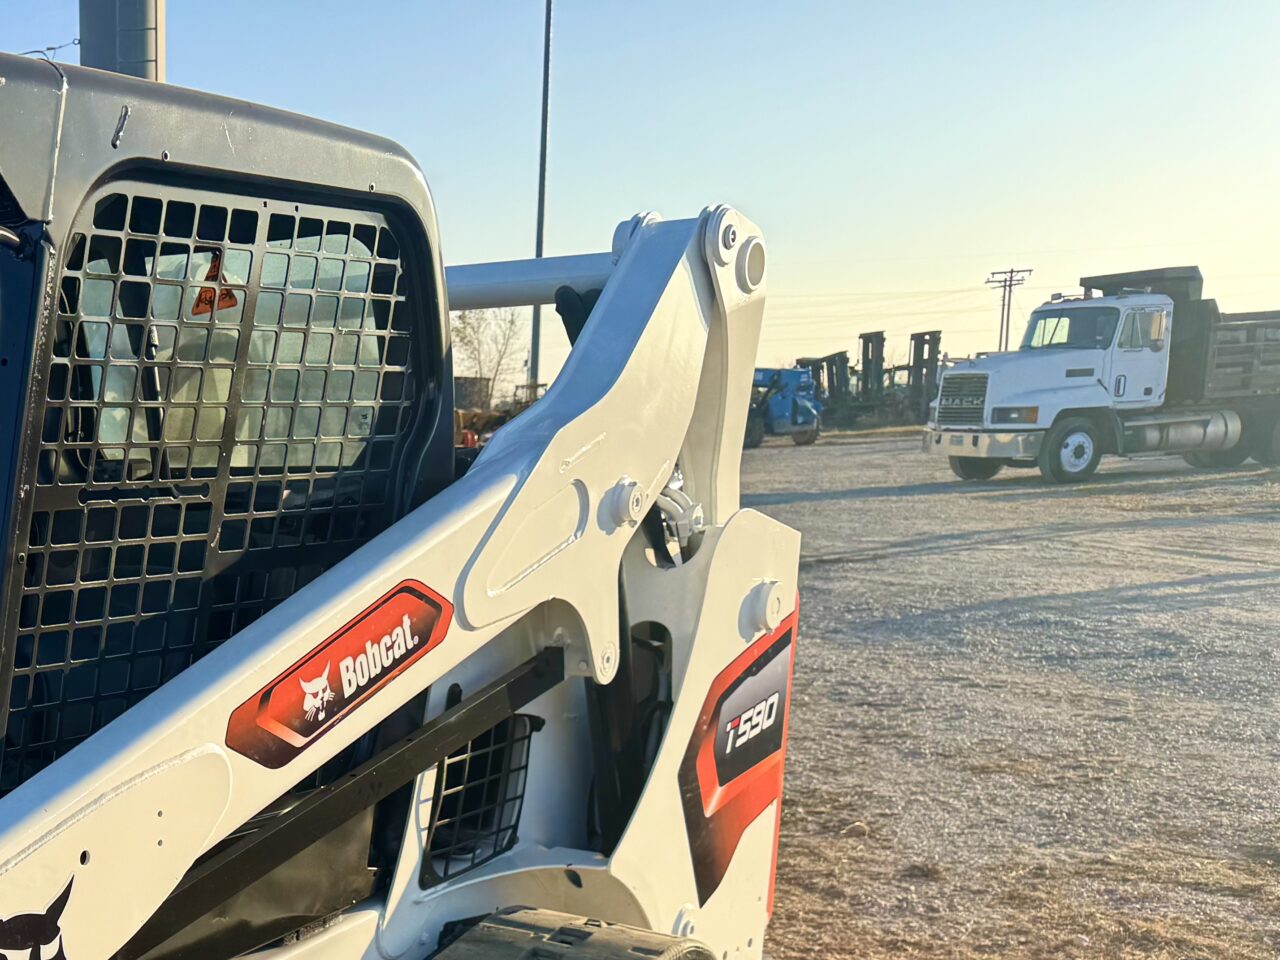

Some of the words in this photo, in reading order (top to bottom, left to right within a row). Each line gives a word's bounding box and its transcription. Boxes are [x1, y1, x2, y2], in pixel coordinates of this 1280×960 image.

[941, 397, 984, 406] MACK
[339, 613, 415, 699] Bobcat
[725, 691, 780, 755] T590
